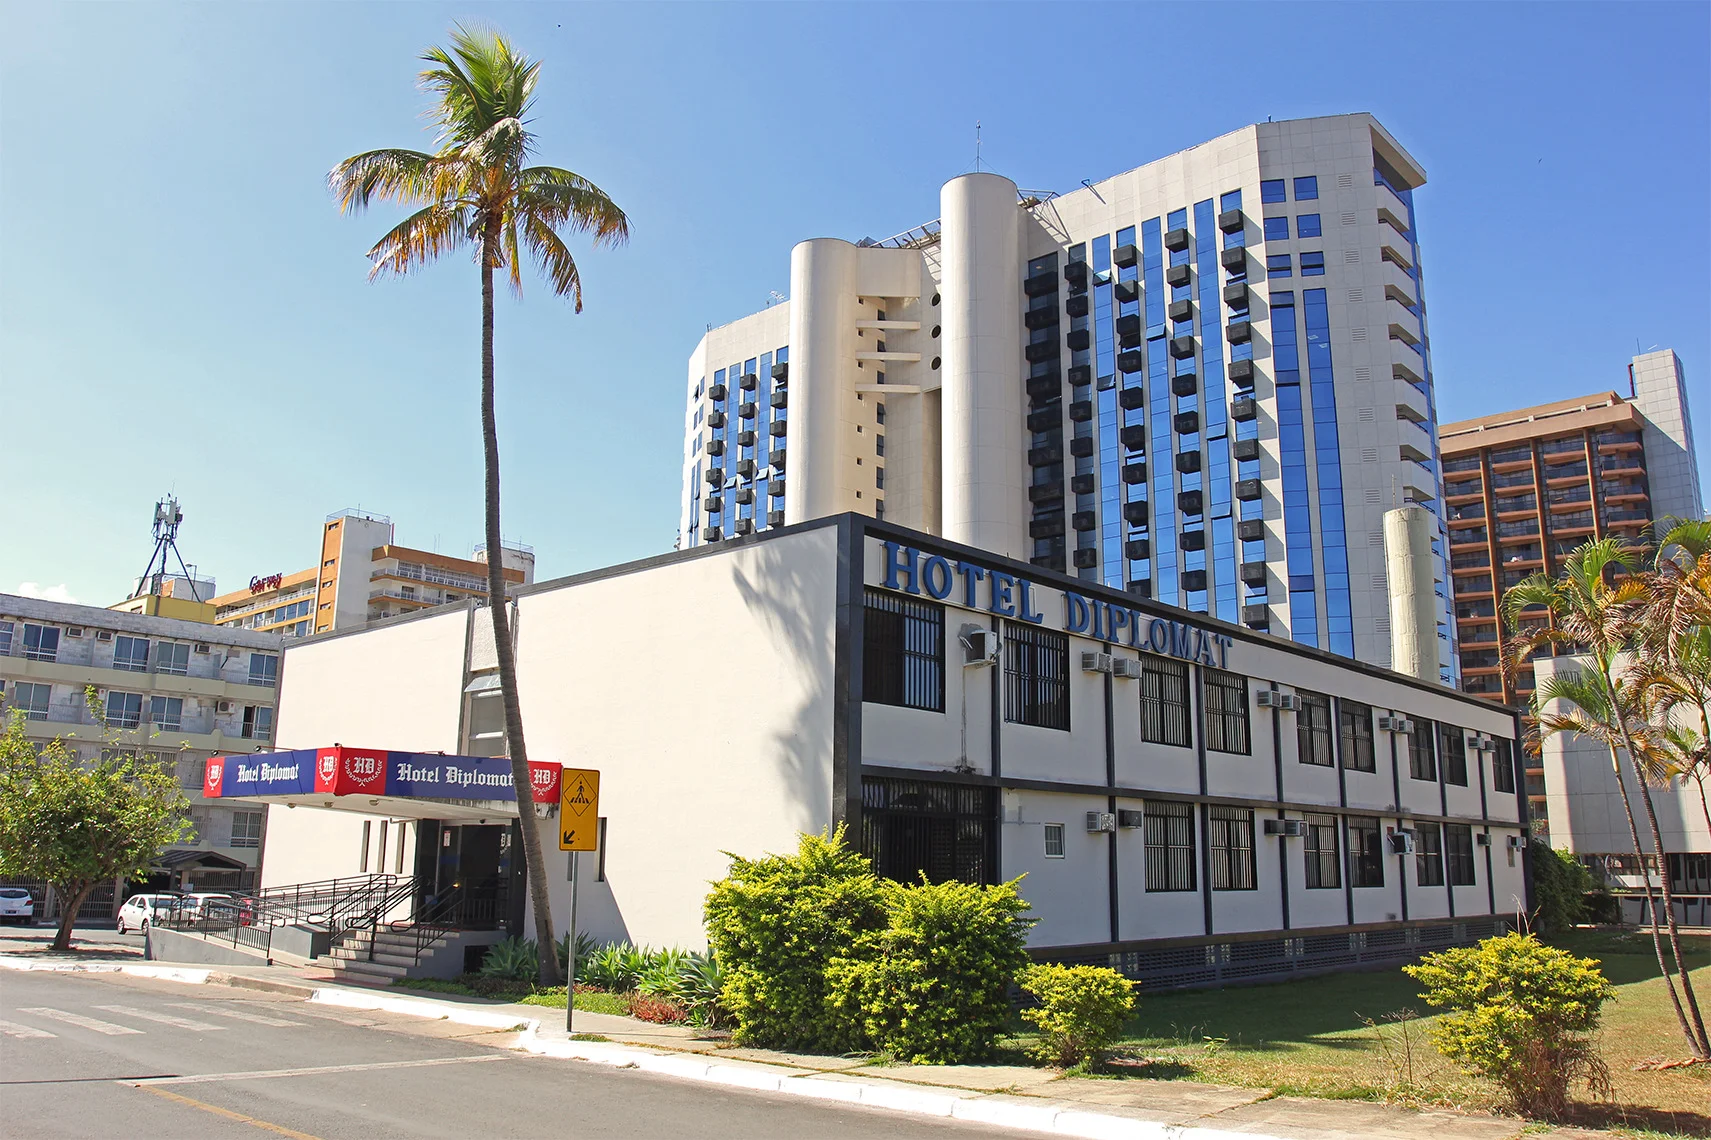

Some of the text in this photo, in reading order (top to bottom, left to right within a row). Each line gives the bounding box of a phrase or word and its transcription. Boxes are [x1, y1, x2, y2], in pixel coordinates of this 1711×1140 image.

[883, 541, 1233, 669] HOTEL DIPLOMAT
[237, 762, 299, 784] Hotel Diplomat
[353, 757, 375, 774] HD
[396, 763, 514, 788] Hotel Diplomat
[533, 768, 551, 785] HD
